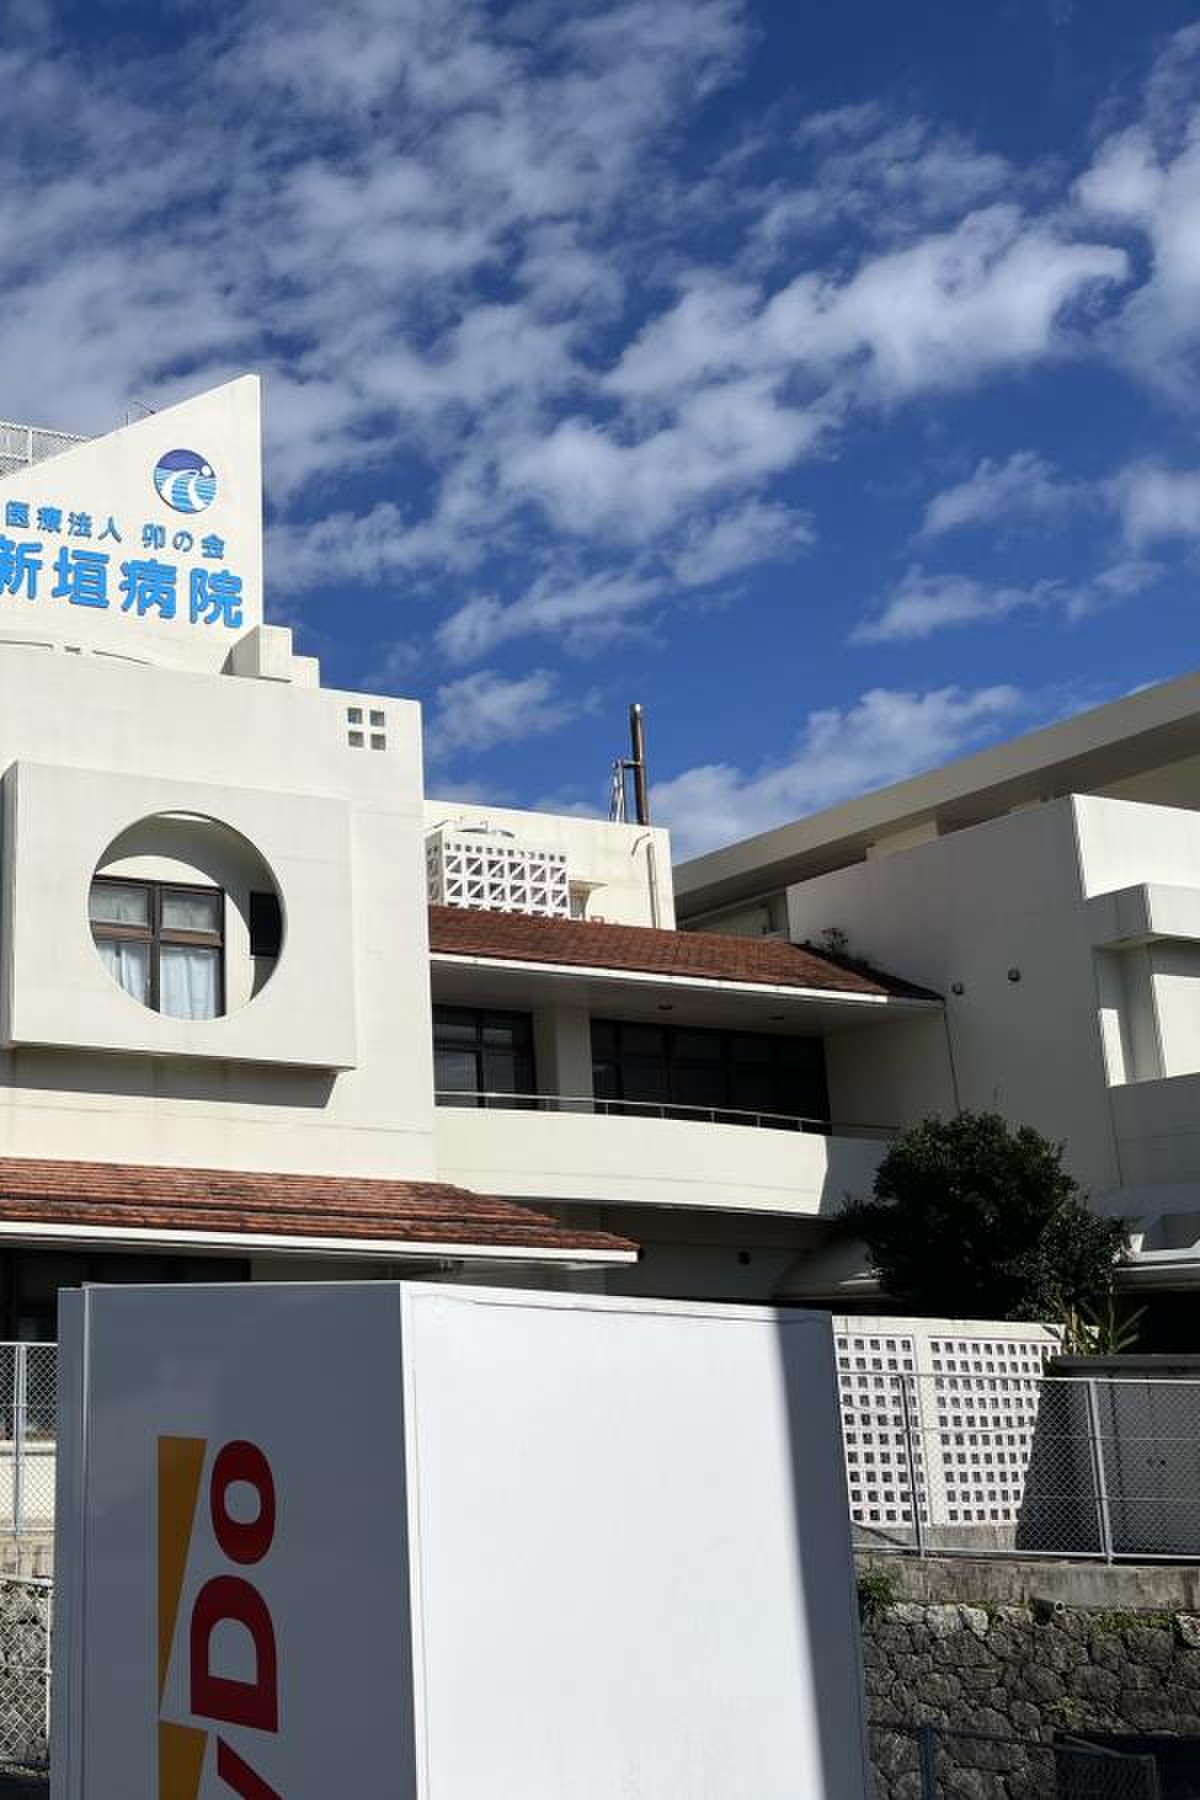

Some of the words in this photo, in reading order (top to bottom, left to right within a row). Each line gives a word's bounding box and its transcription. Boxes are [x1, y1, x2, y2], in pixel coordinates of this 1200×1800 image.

[5, 500, 123, 543] 医療法人
[141, 523, 225, 560] 卯の会
